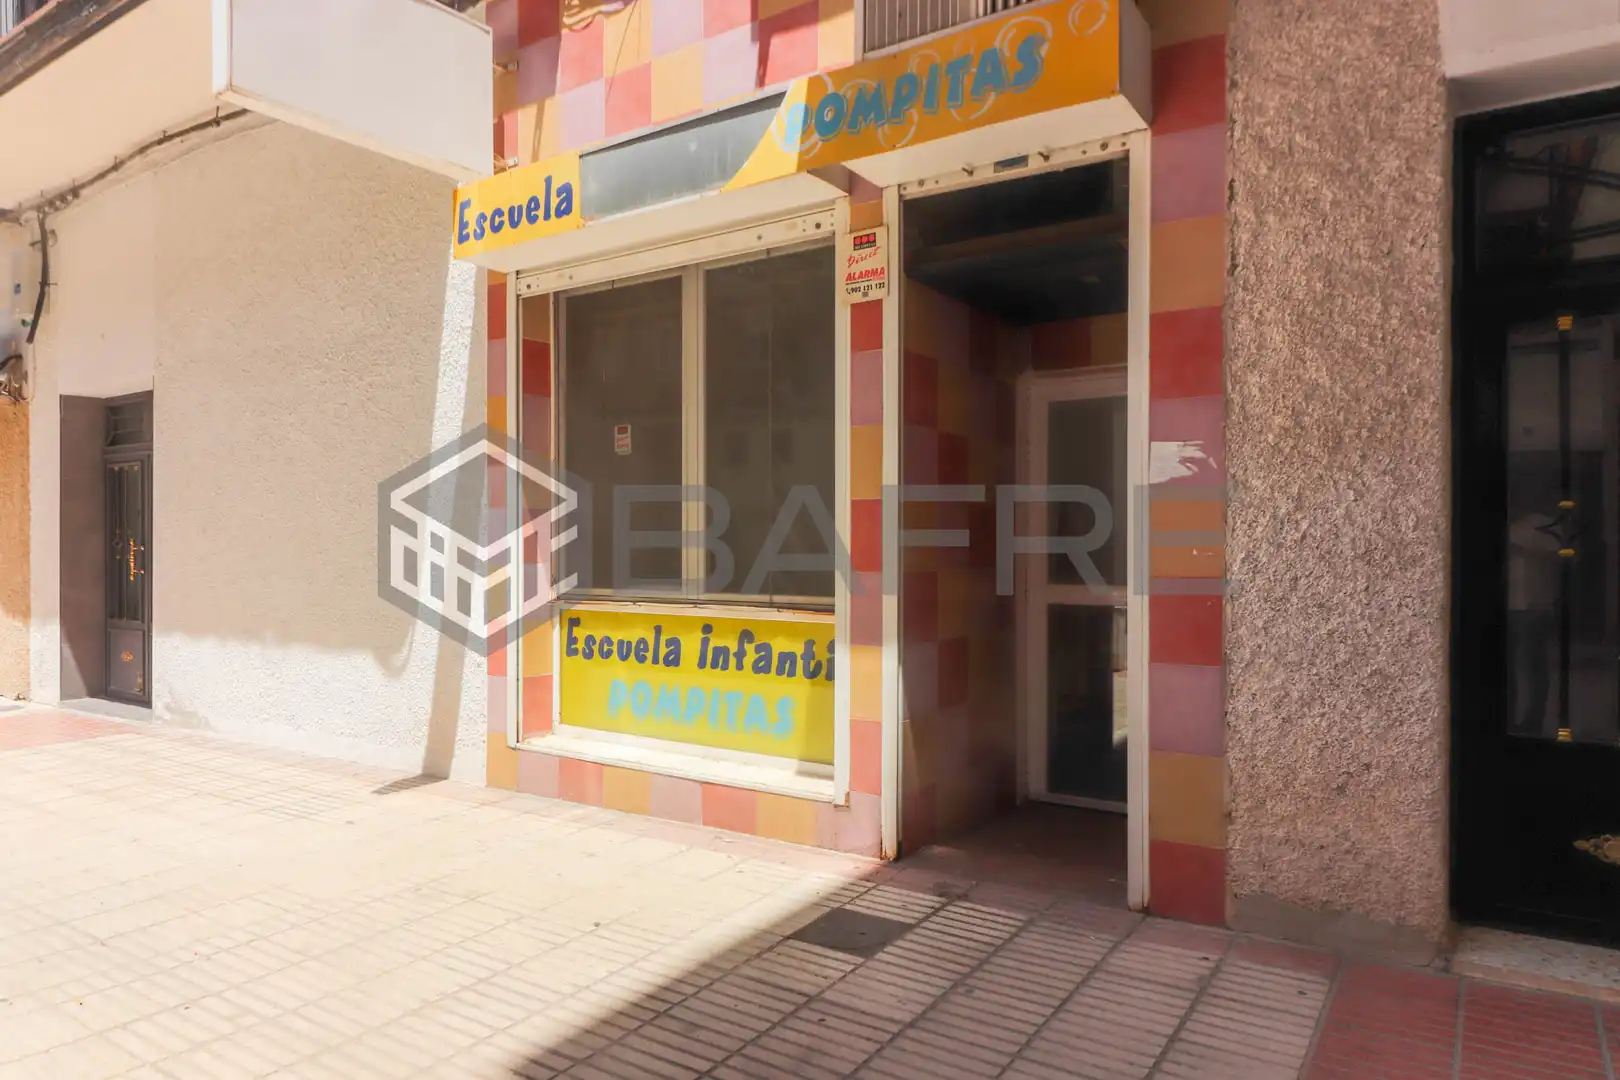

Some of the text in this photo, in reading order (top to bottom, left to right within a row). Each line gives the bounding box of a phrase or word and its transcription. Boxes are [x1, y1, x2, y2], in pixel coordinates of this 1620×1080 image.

[784, 32, 1046, 152] POMPITAS
[457, 174, 573, 245] Escuela
[845, 266, 885, 282] ALARMA
[863, 284, 873, 292] 121
[875, 281, 885, 290] 122
[565, 616, 682, 668] Escuela
[608, 679, 797, 741] POMPITAS
